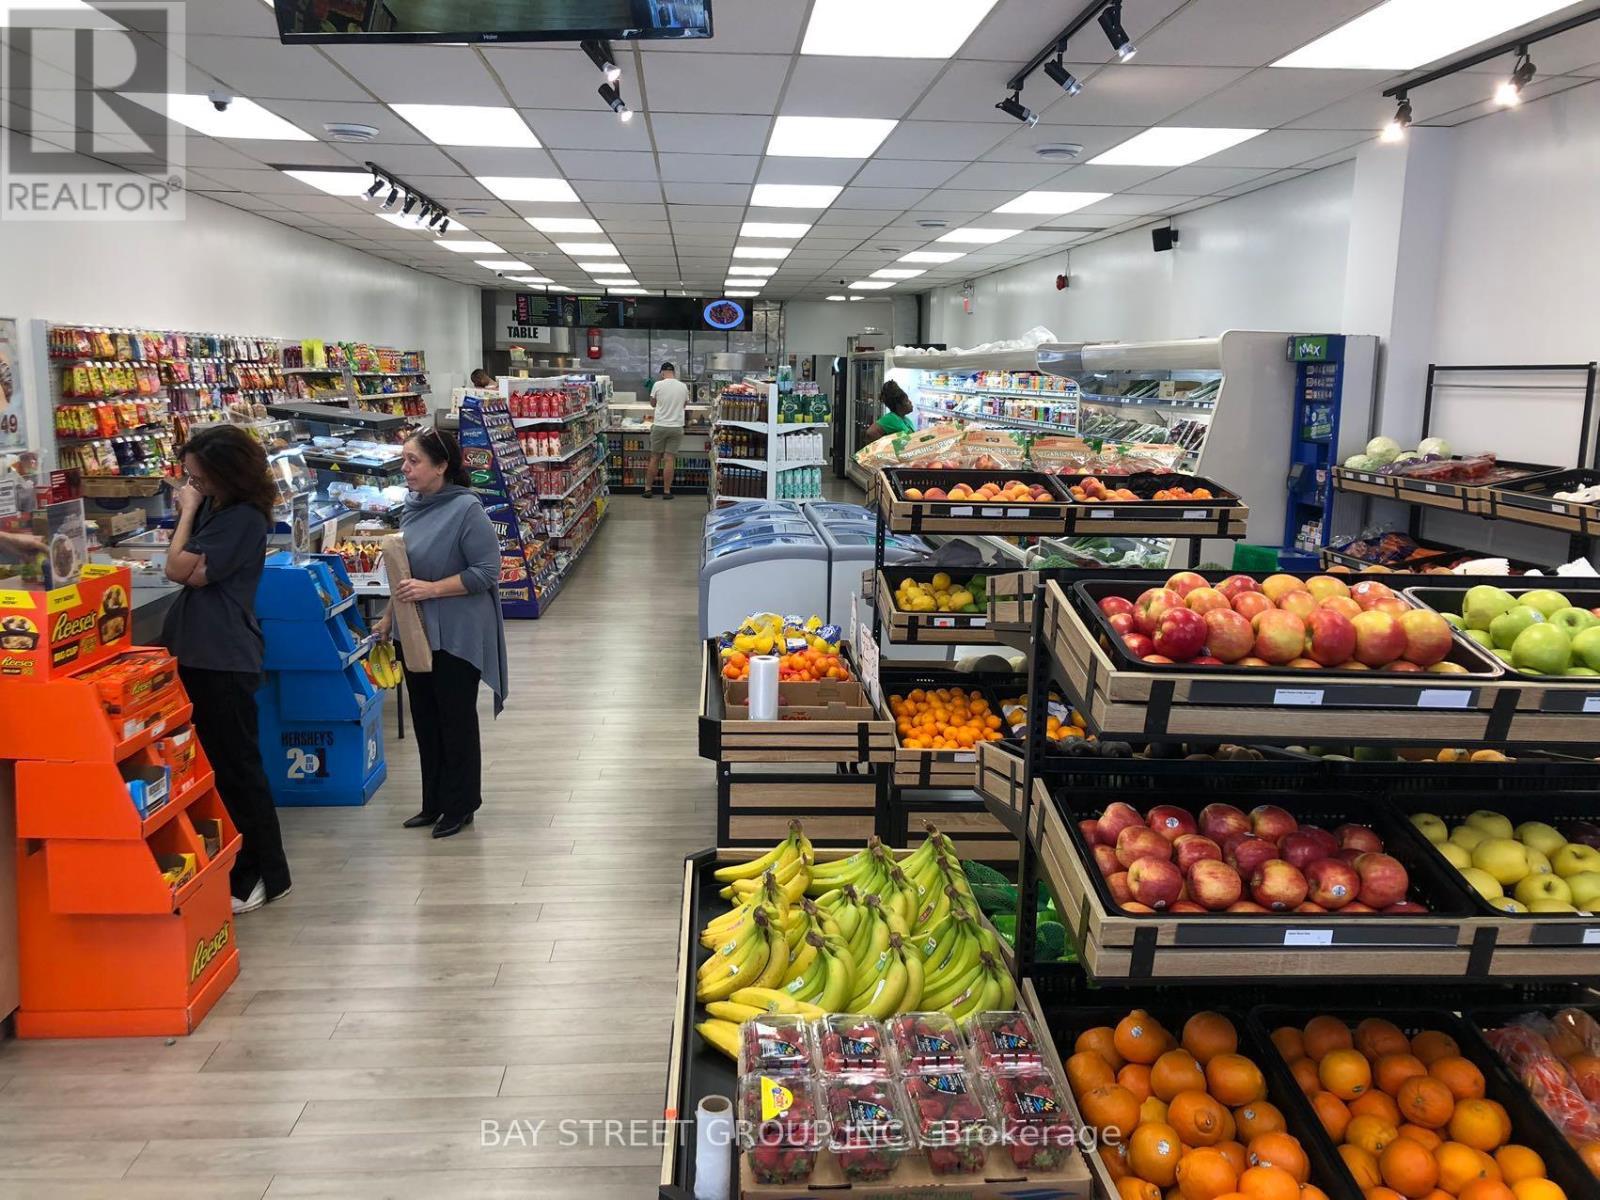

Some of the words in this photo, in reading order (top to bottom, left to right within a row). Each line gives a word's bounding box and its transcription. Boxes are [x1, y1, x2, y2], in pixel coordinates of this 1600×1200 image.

[507, 326, 539, 339] TABLE
[1299, 343, 1320, 357] MAX
[52, 611, 98, 642] Reese's
[281, 731, 334, 746] HERSHEY'S
[191, 920, 230, 983] Reese's
